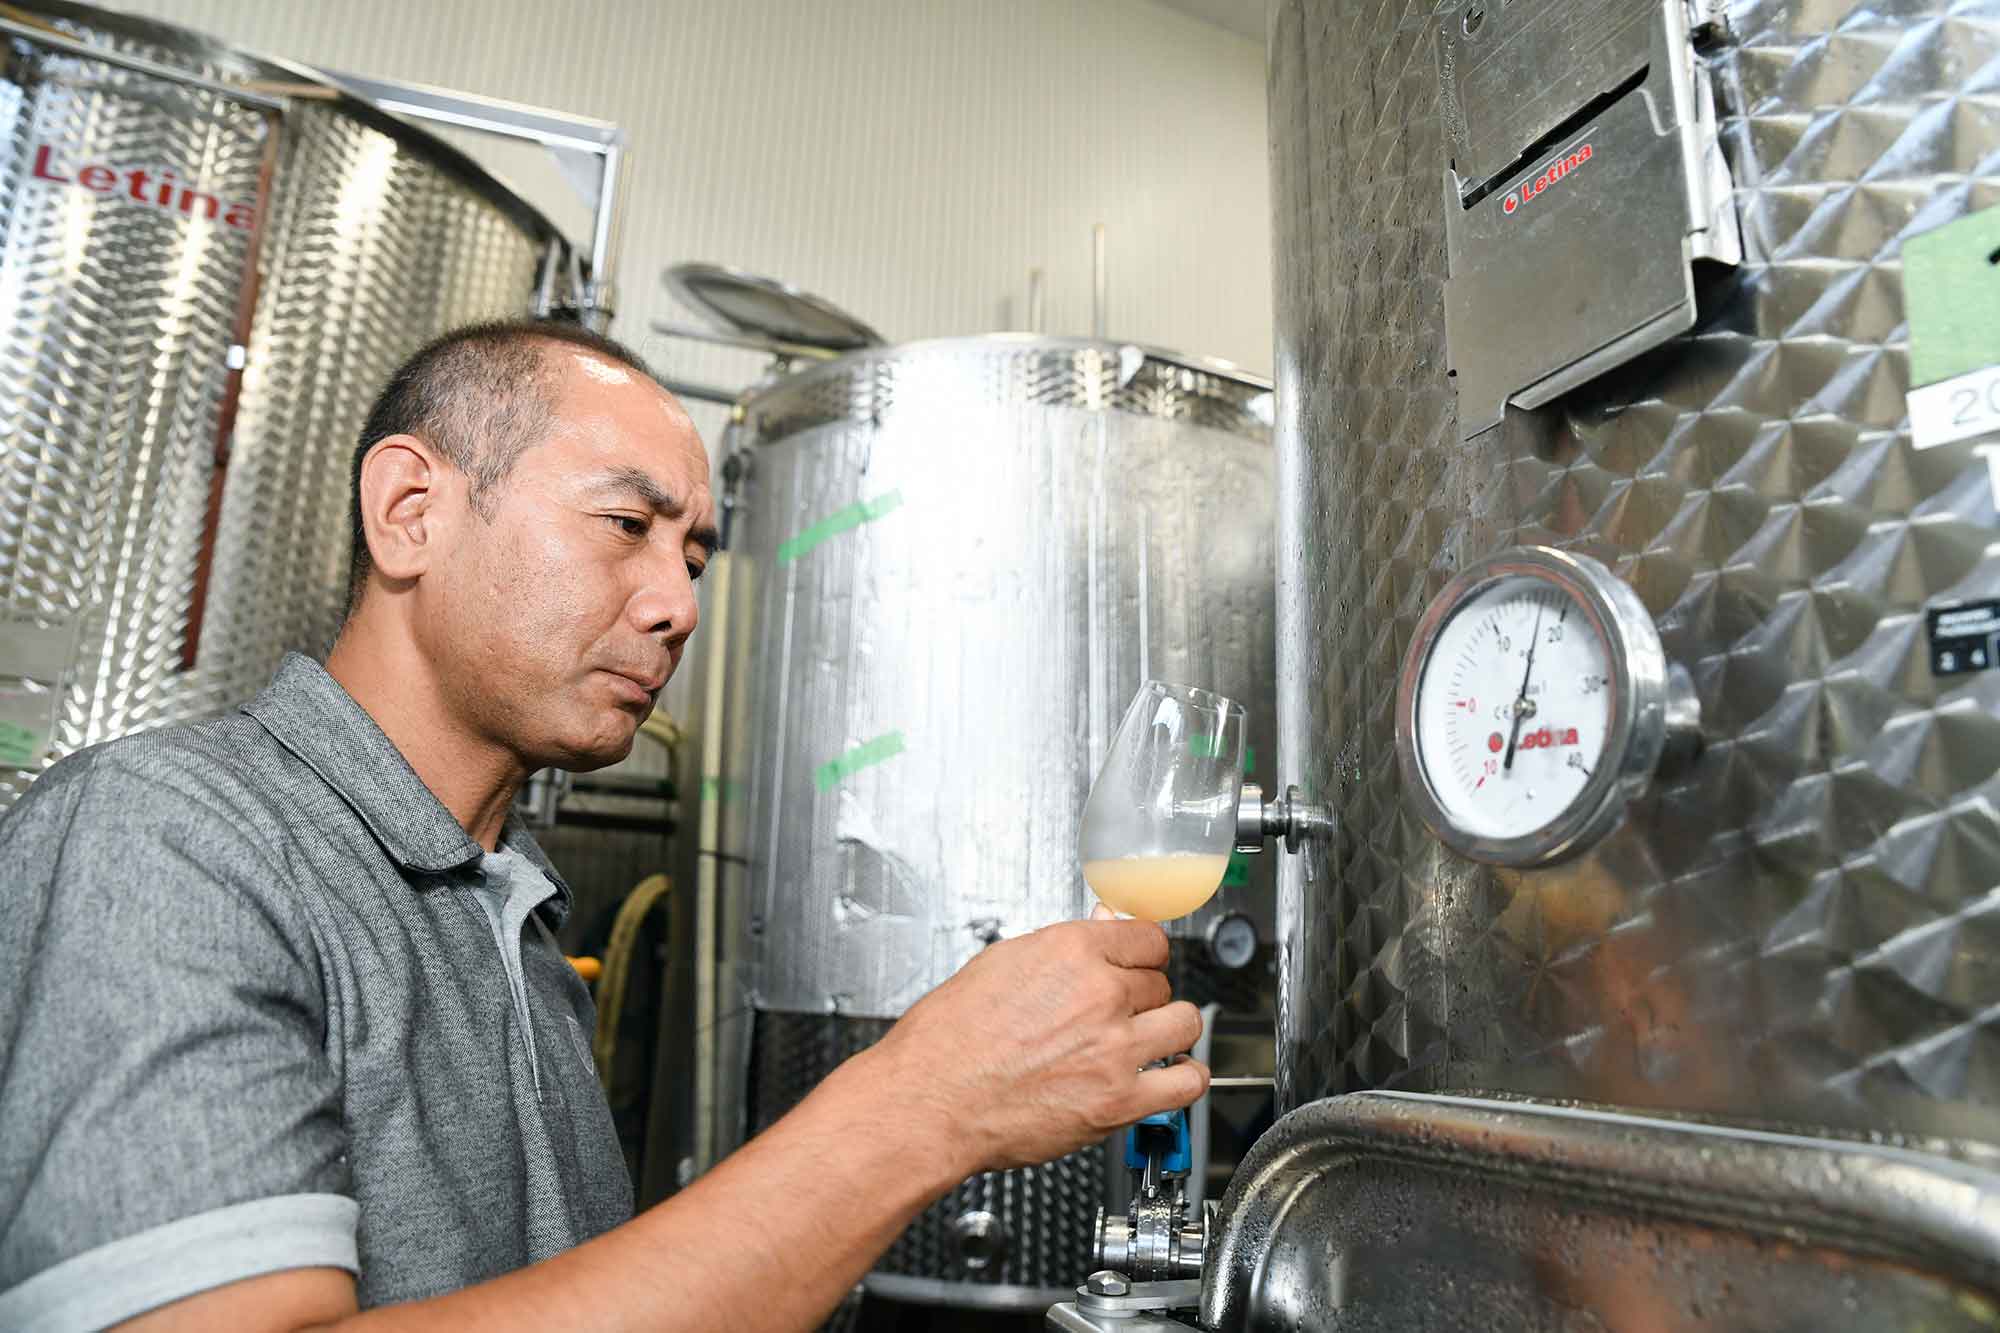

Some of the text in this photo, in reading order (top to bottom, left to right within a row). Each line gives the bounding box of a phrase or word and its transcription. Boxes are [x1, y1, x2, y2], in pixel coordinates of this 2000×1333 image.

[32, 144, 257, 229] Letina
[1521, 144, 1593, 203] Letina
[1497, 635, 1511, 652] 10
[1547, 624, 1563, 644] 20
